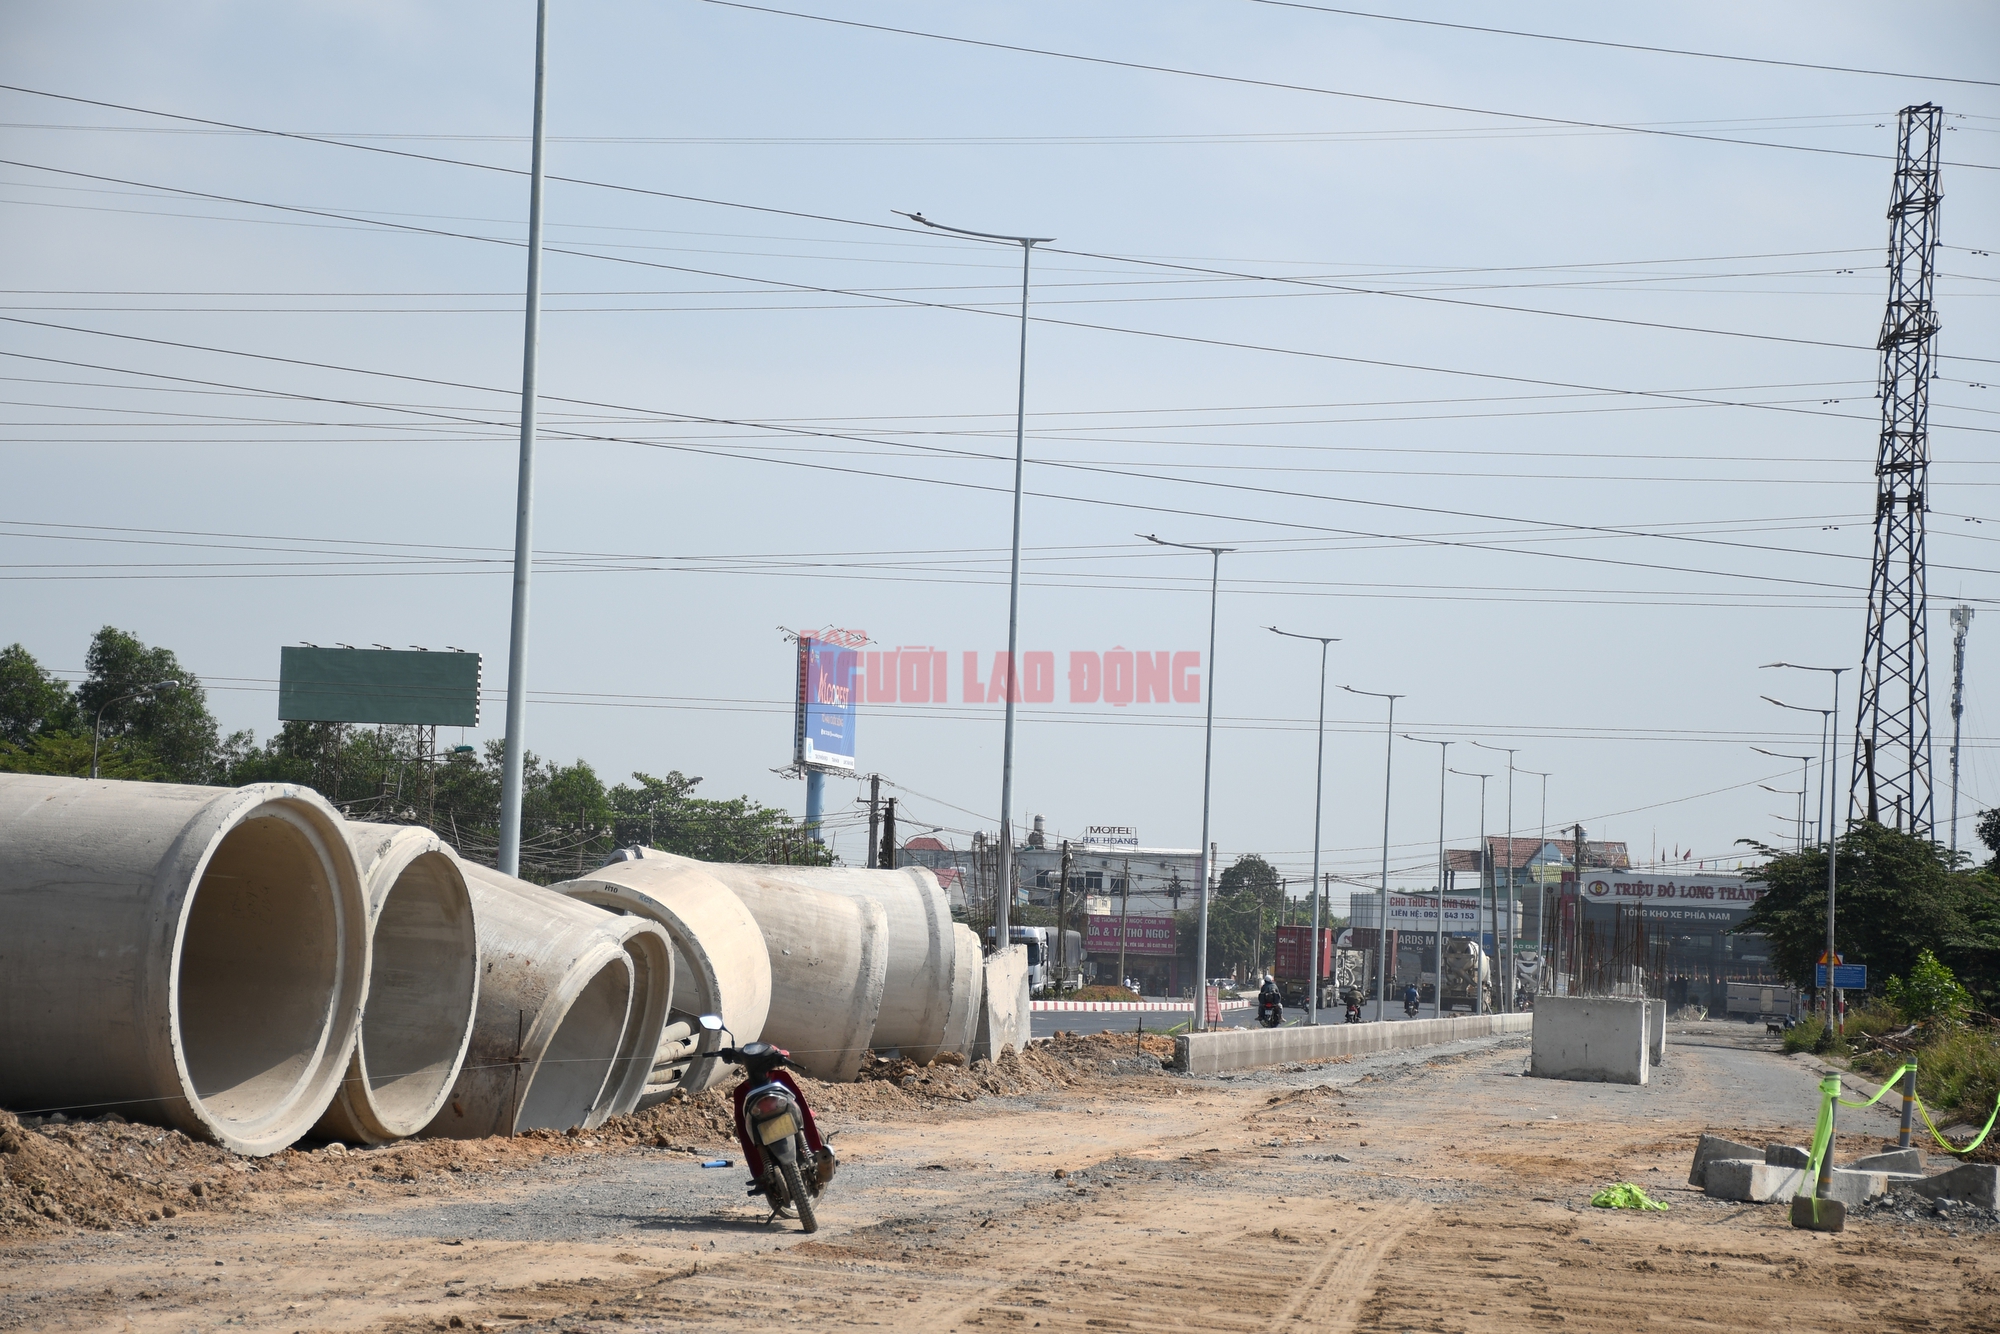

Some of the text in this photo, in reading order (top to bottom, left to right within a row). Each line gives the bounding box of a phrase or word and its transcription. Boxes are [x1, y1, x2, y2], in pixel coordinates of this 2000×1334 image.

[1090, 826, 1132, 835] MOTEL
[1103, 835, 1139, 846] HOÀNG
[604, 884, 619, 893] H10
[1614, 880, 1655, 899] TRIỆU
[1657, 881, 1676, 898] ĐÔ
[1680, 885, 1714, 900] LONG
[1389, 896, 1406, 907] CHO
[1391, 909, 1408, 917] LIÊN
[1423, 910, 1442, 919] 093
[1444, 911, 1459, 920] 643
[1461, 912, 1475, 920] 153
[1649, 909, 1669, 918] KHO
[1670, 911, 1683, 919] XE
[1684, 910, 1706, 920] PHÍA
[1708, 912, 1731, 921] NAM
[1145, 929, 1170, 941] NGỌC
[1398, 935, 1424, 945] ARDS
